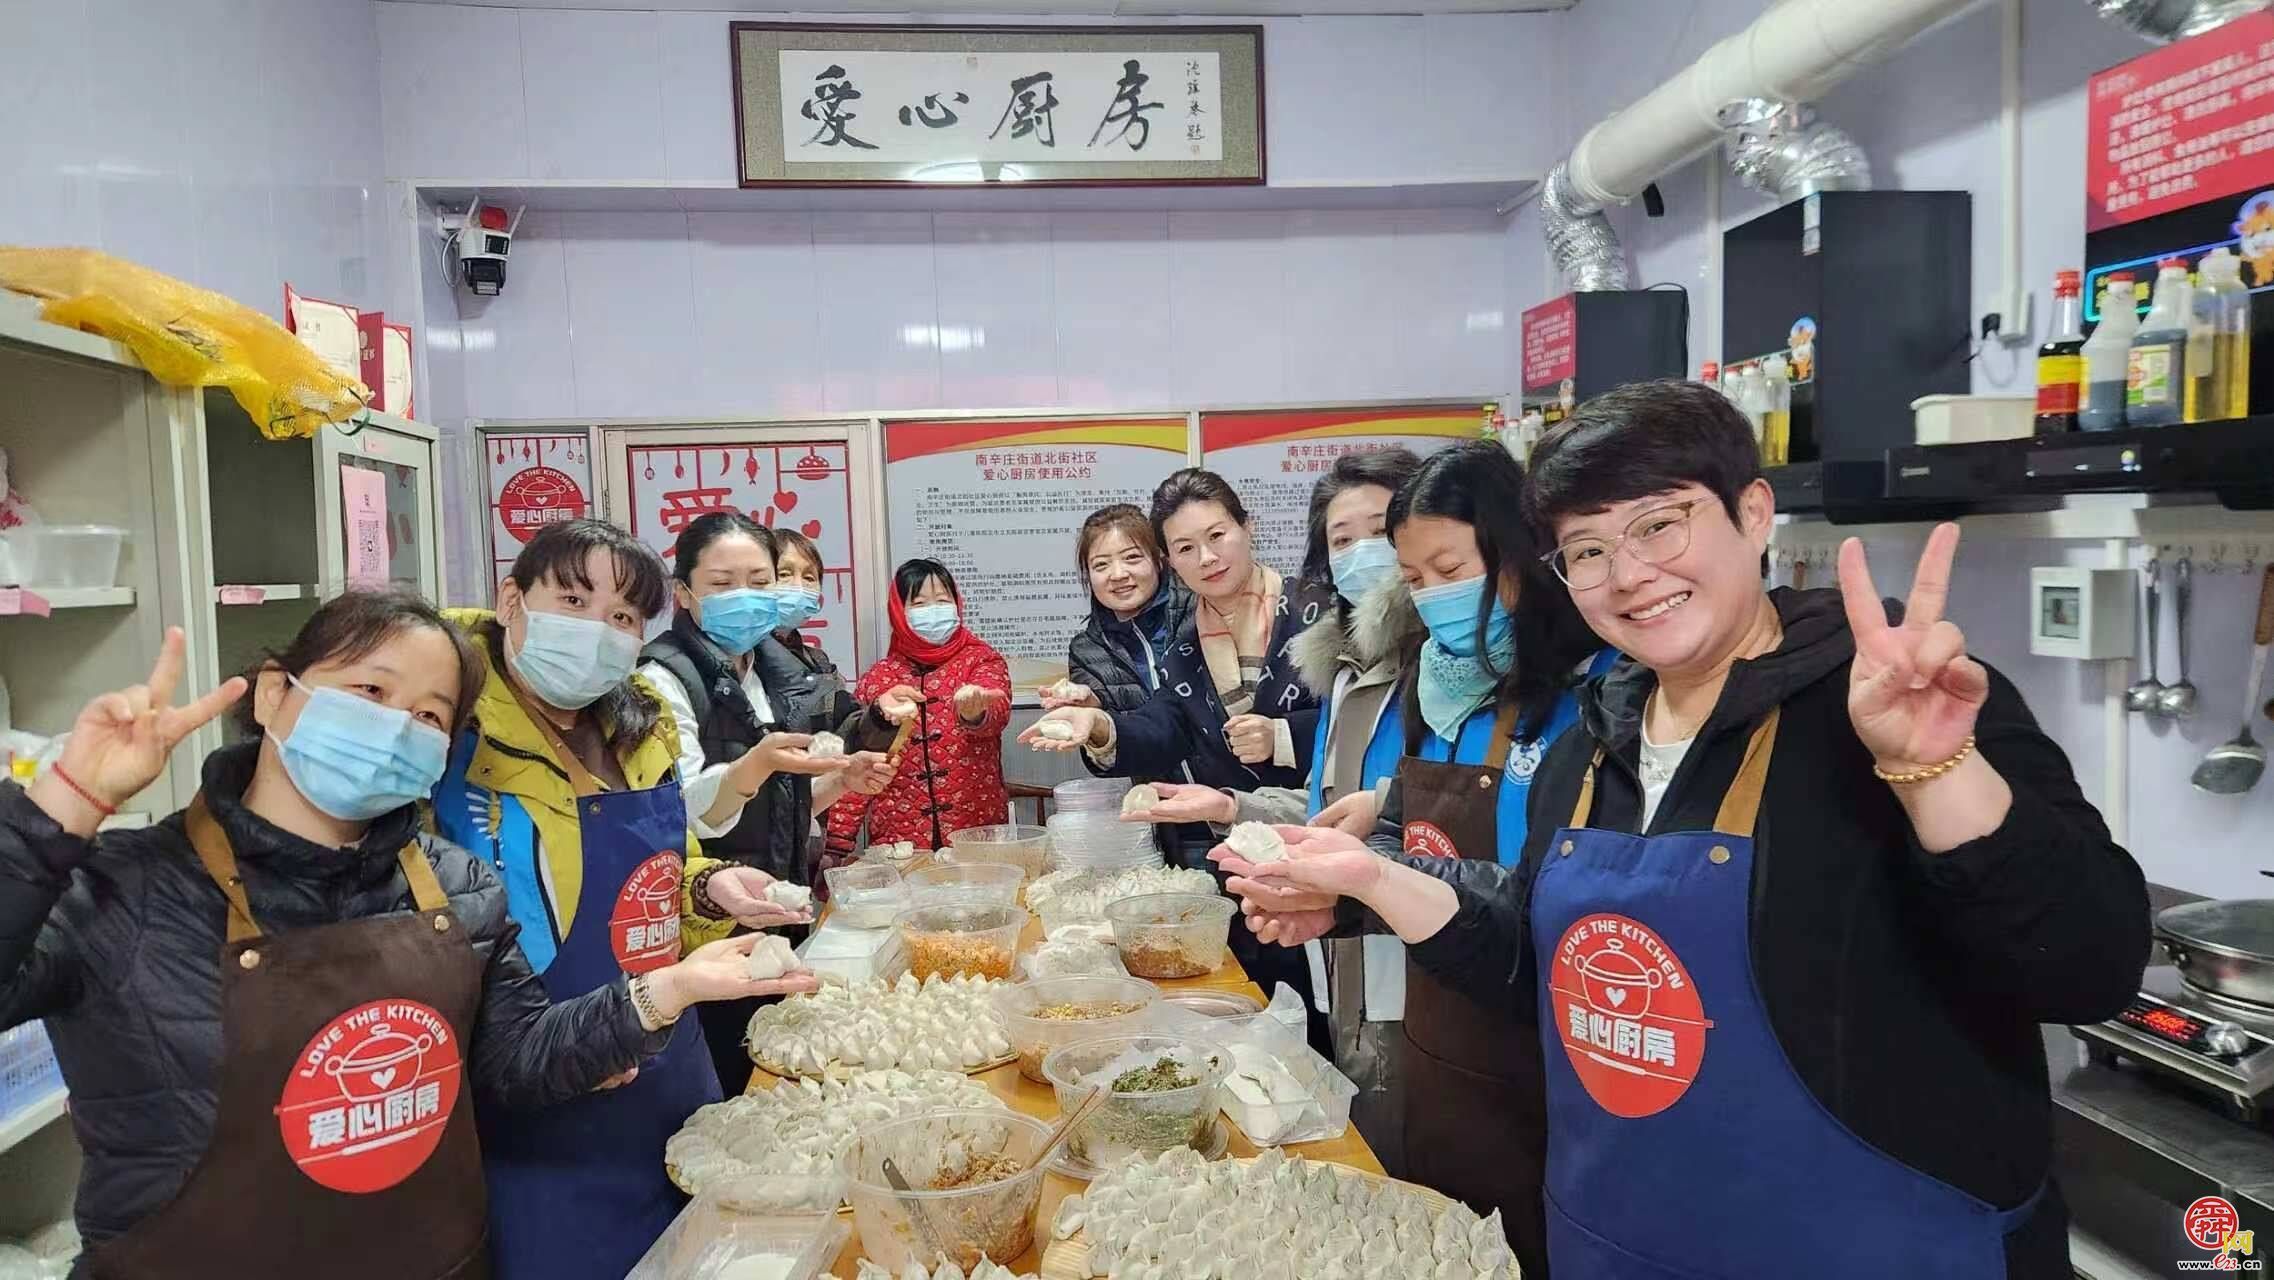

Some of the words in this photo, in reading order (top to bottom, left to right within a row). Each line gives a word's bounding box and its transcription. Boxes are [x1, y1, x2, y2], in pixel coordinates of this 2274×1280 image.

[800, 59, 1165, 151] 爱心厨房
[506, 475, 524, 494] LOVE
[525, 469, 541, 477] THE
[544, 469, 576, 492] KITCHEN
[976, 451, 1097, 466] 南辛庄街道北街社区
[984, 467, 1091, 480] 爱心厨房使用公约
[1409, 826, 1425, 837] THE
[623, 867, 650, 902] LOVE
[1561, 926, 1589, 965] LOVE
[1590, 919, 1617, 934] THE
[1621, 922, 1684, 989] KITCHEN
[300, 1026, 344, 1078] LOVE
[344, 1007, 380, 1031] THE
[387, 1005, 448, 1045] KITCHEN
[1568, 1003, 1676, 1067] 爱心厨房
[309, 1081, 440, 1149] 爱心厨房
